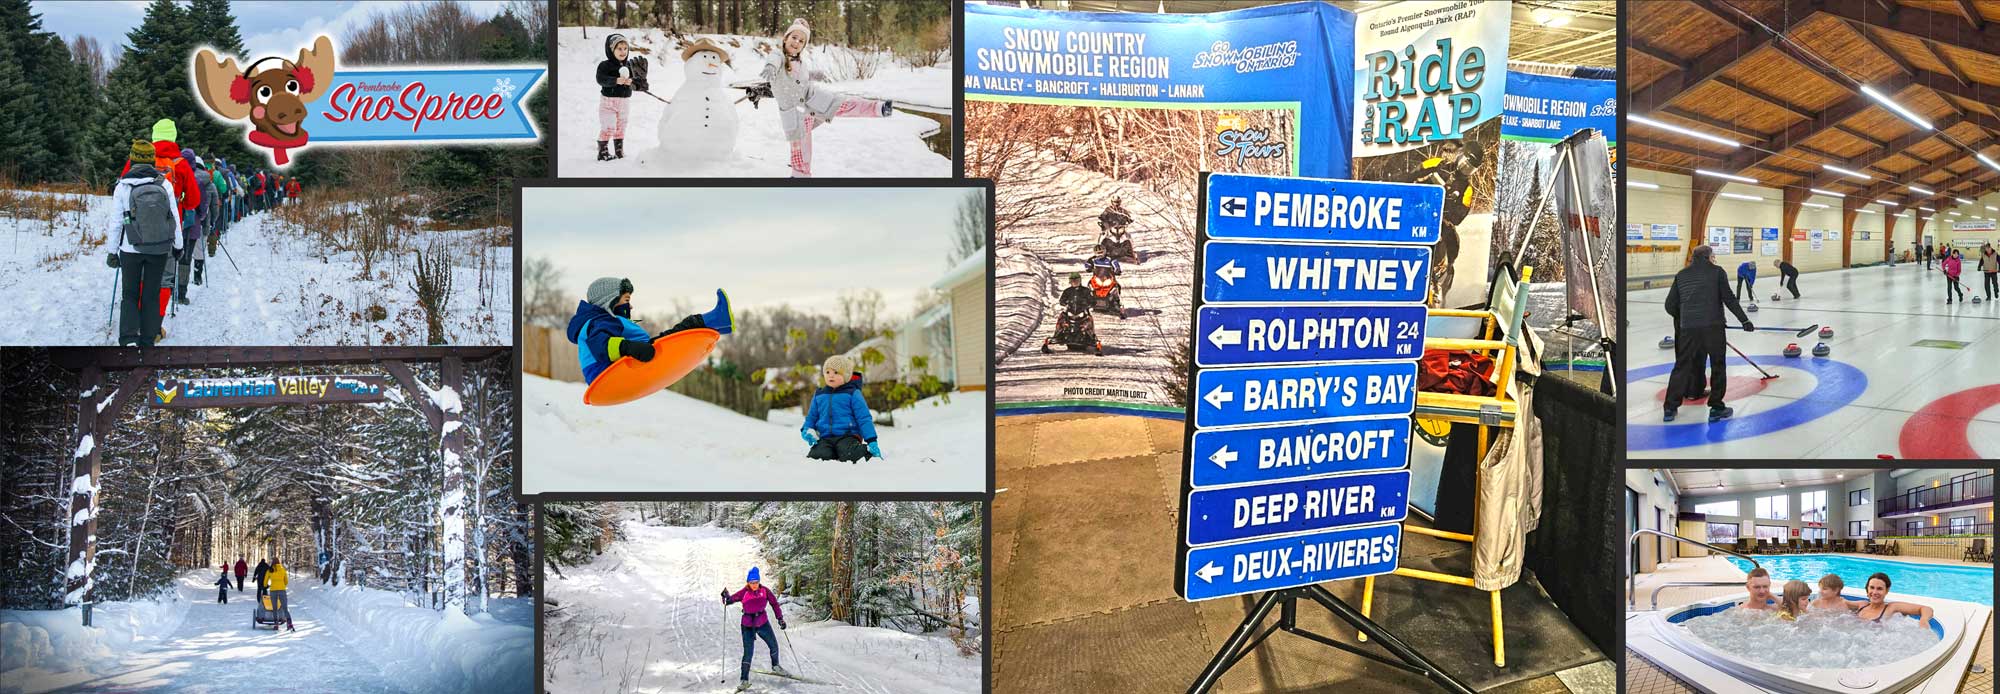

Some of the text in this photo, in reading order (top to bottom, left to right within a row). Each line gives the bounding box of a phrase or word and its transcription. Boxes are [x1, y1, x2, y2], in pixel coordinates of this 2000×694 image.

[1370, 18, 1396, 30] Ontario's
[1397, 12, 1423, 24] Premier
[1424, 1, 1468, 17] Snowmobile
[1380, 9, 1476, 37] Round Algonquin Park (RAP)
[1003, 27, 1146, 55] SNOW COUNTRY
[1192, 41, 1297, 68] SNOWMOBILING
[1211, 41, 1230, 53] GO
[977, 48, 1169, 79] SNOWMOBILE REGION
[1236, 54, 1295, 73] ONTARIO!
[1363, 37, 1486, 100] Ride
[983, 76, 1024, 91] VALLEY
[1035, 80, 1089, 94] BANCROFT
[1100, 82, 1158, 97] HALIBURTON
[1168, 84, 1204, 98] LANARK
[1361, 91, 1481, 145] the RAP
[1503, 94, 1587, 118] OWMOBILE REGION
[1506, 115, 1519, 126] LAKE
[1521, 117, 1545, 129] SHARBOT
[1546, 119, 1561, 130] LAKE
[1217, 127, 1270, 156] Snow
[1235, 141, 1286, 167] Tours
[1254, 191, 1403, 230] PEMBROKE
[1411, 226, 1427, 238] KM
[1267, 256, 1423, 291] WHITNEY
[1247, 316, 1419, 351] ROLPHTON 24
[1396, 343, 1411, 355] KM
[183, 379, 276, 398] Laurentian
[278, 377, 330, 399] Valley
[1063, 387, 1148, 399] PHOTO CREDIT MARTIN LORTZ
[1243, 374, 1412, 412] BARRY'S BAY
[1258, 429, 1395, 470] BANCROFT
[1233, 484, 1376, 529] DEEP RIVER
[1380, 506, 1396, 518] KM
[1232, 534, 1395, 583] DEUX-RIVIERES
